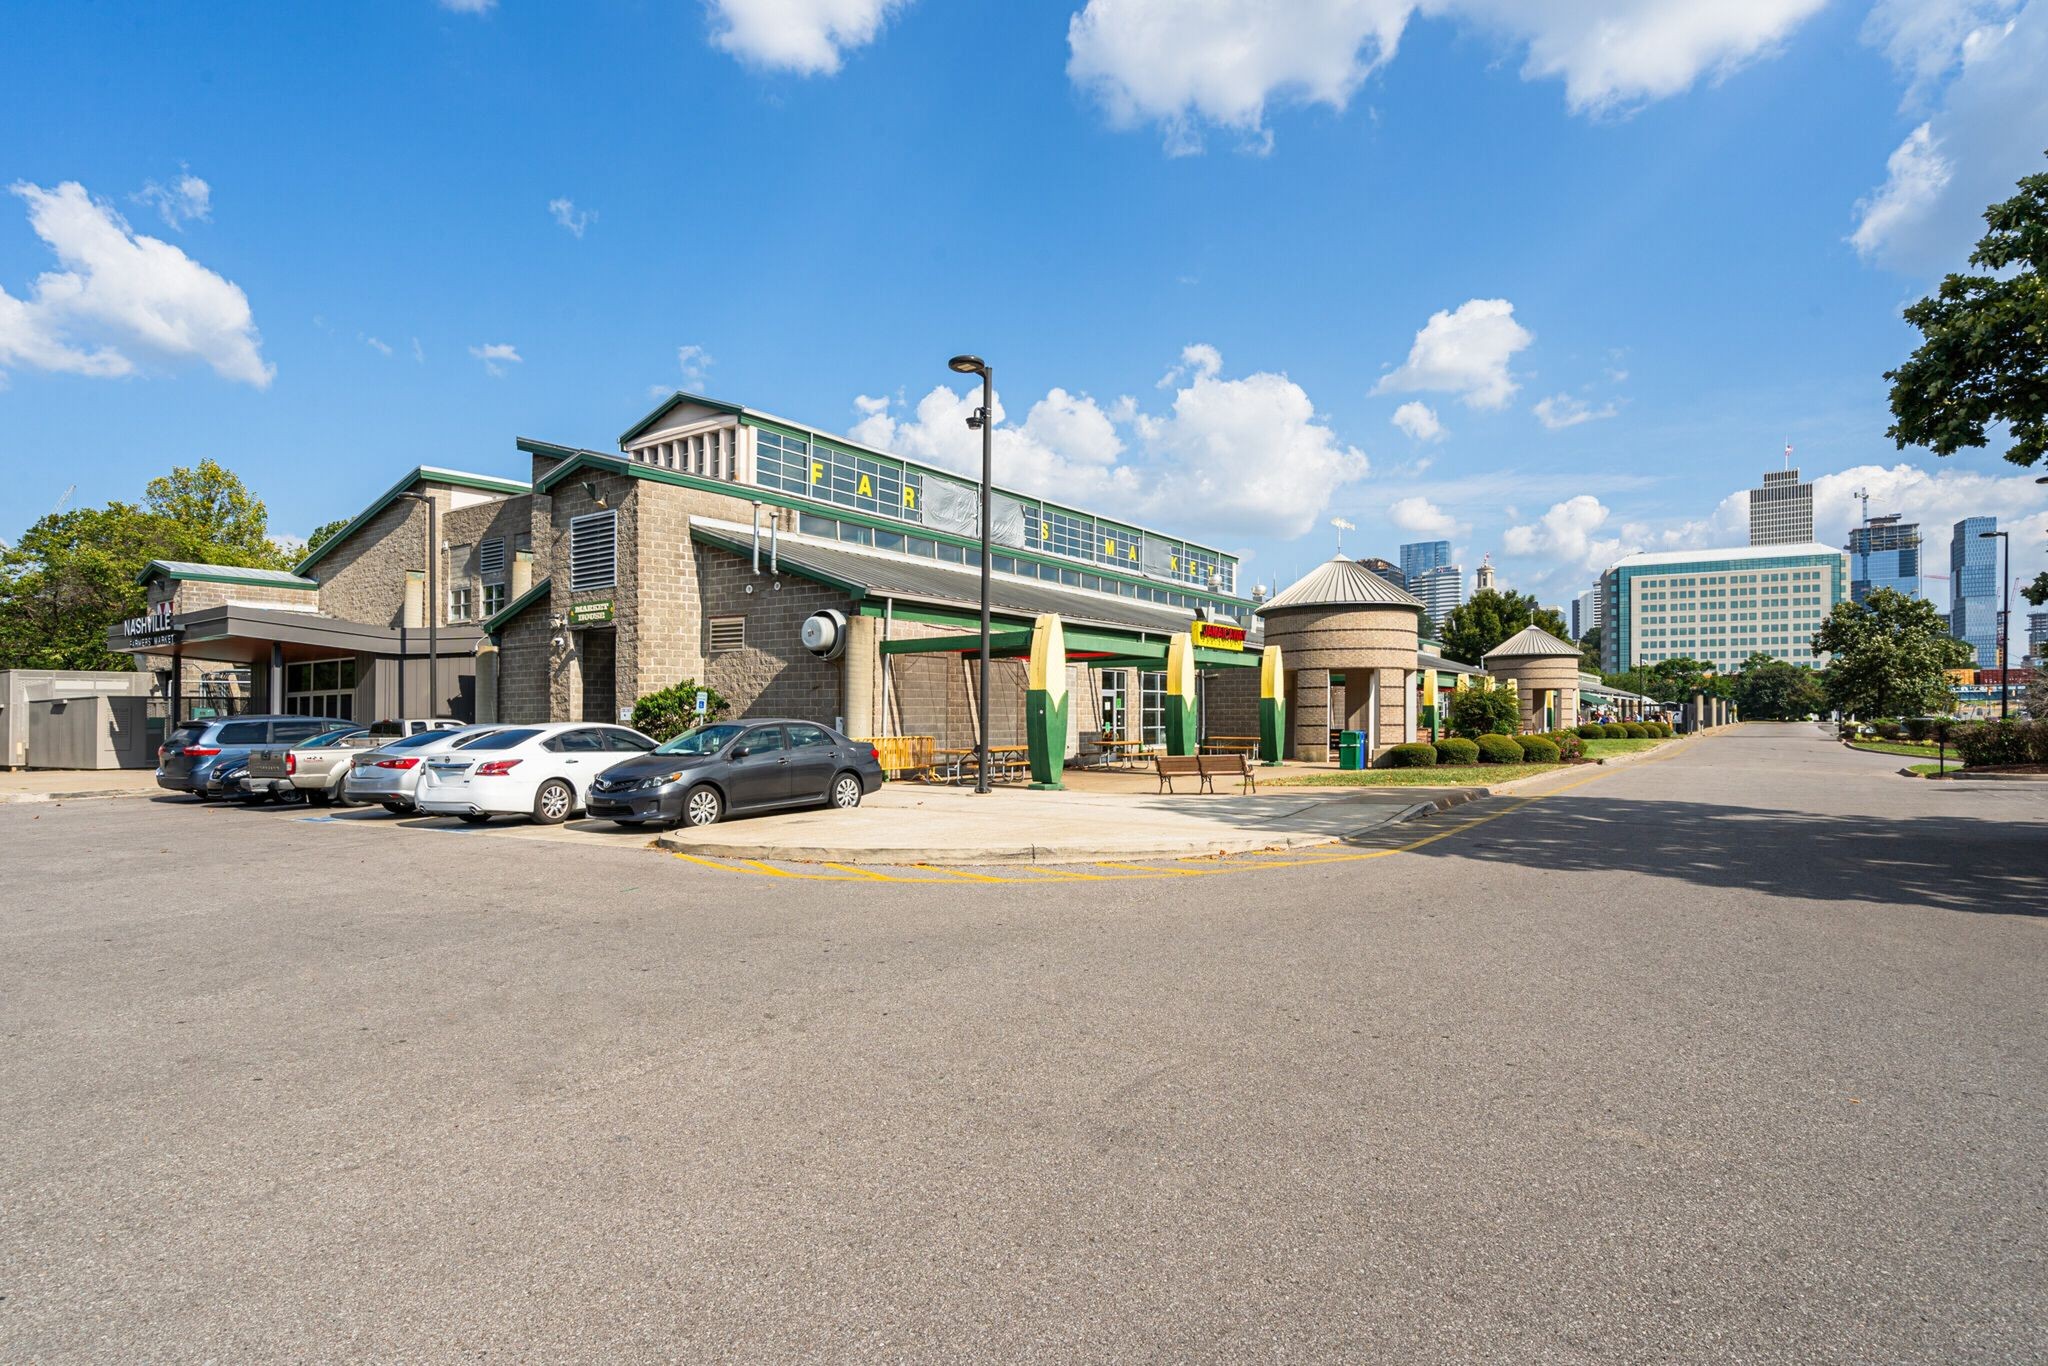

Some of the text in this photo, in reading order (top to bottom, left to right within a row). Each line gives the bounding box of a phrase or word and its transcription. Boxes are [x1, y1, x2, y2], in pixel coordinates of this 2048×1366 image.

[1105, 538, 1214, 578] MAKET
[575, 603, 609, 613] MARKET
[578, 612, 605, 621] HOUSE
[124, 614, 171, 637] NASHVILLE
[153, 634, 175, 645] MARKET
